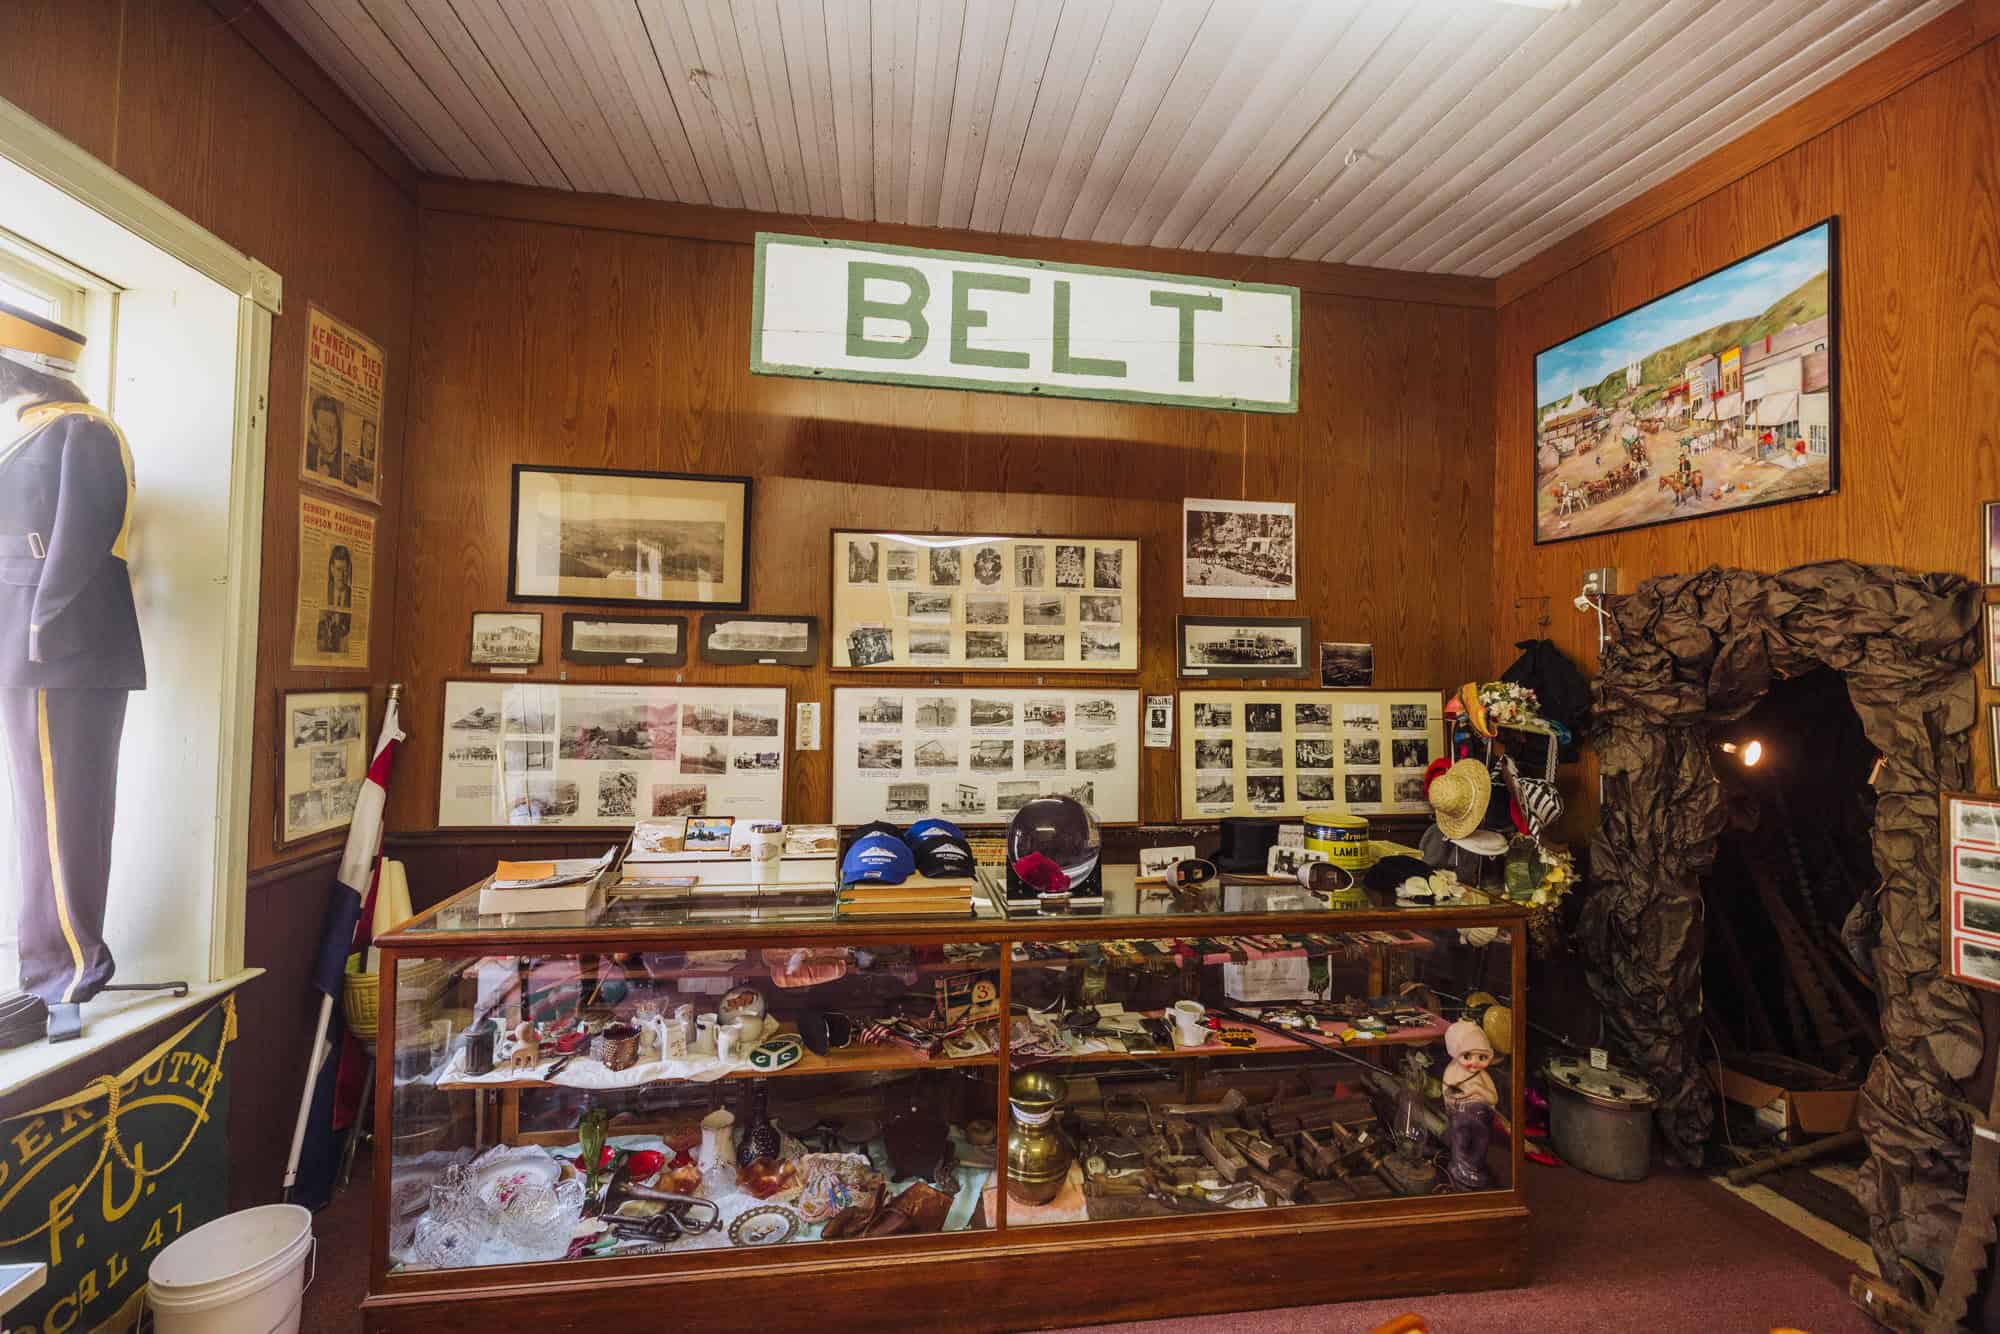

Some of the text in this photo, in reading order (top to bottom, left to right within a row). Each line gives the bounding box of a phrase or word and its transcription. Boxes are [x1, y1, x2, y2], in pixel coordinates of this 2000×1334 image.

[312, 322, 356, 361] KENNEDY
[845, 260, 1223, 382] BELT
[311, 341, 321, 361] IN
[119, 1050, 223, 1097] UTTE
[140, 1201, 183, 1251] 47
